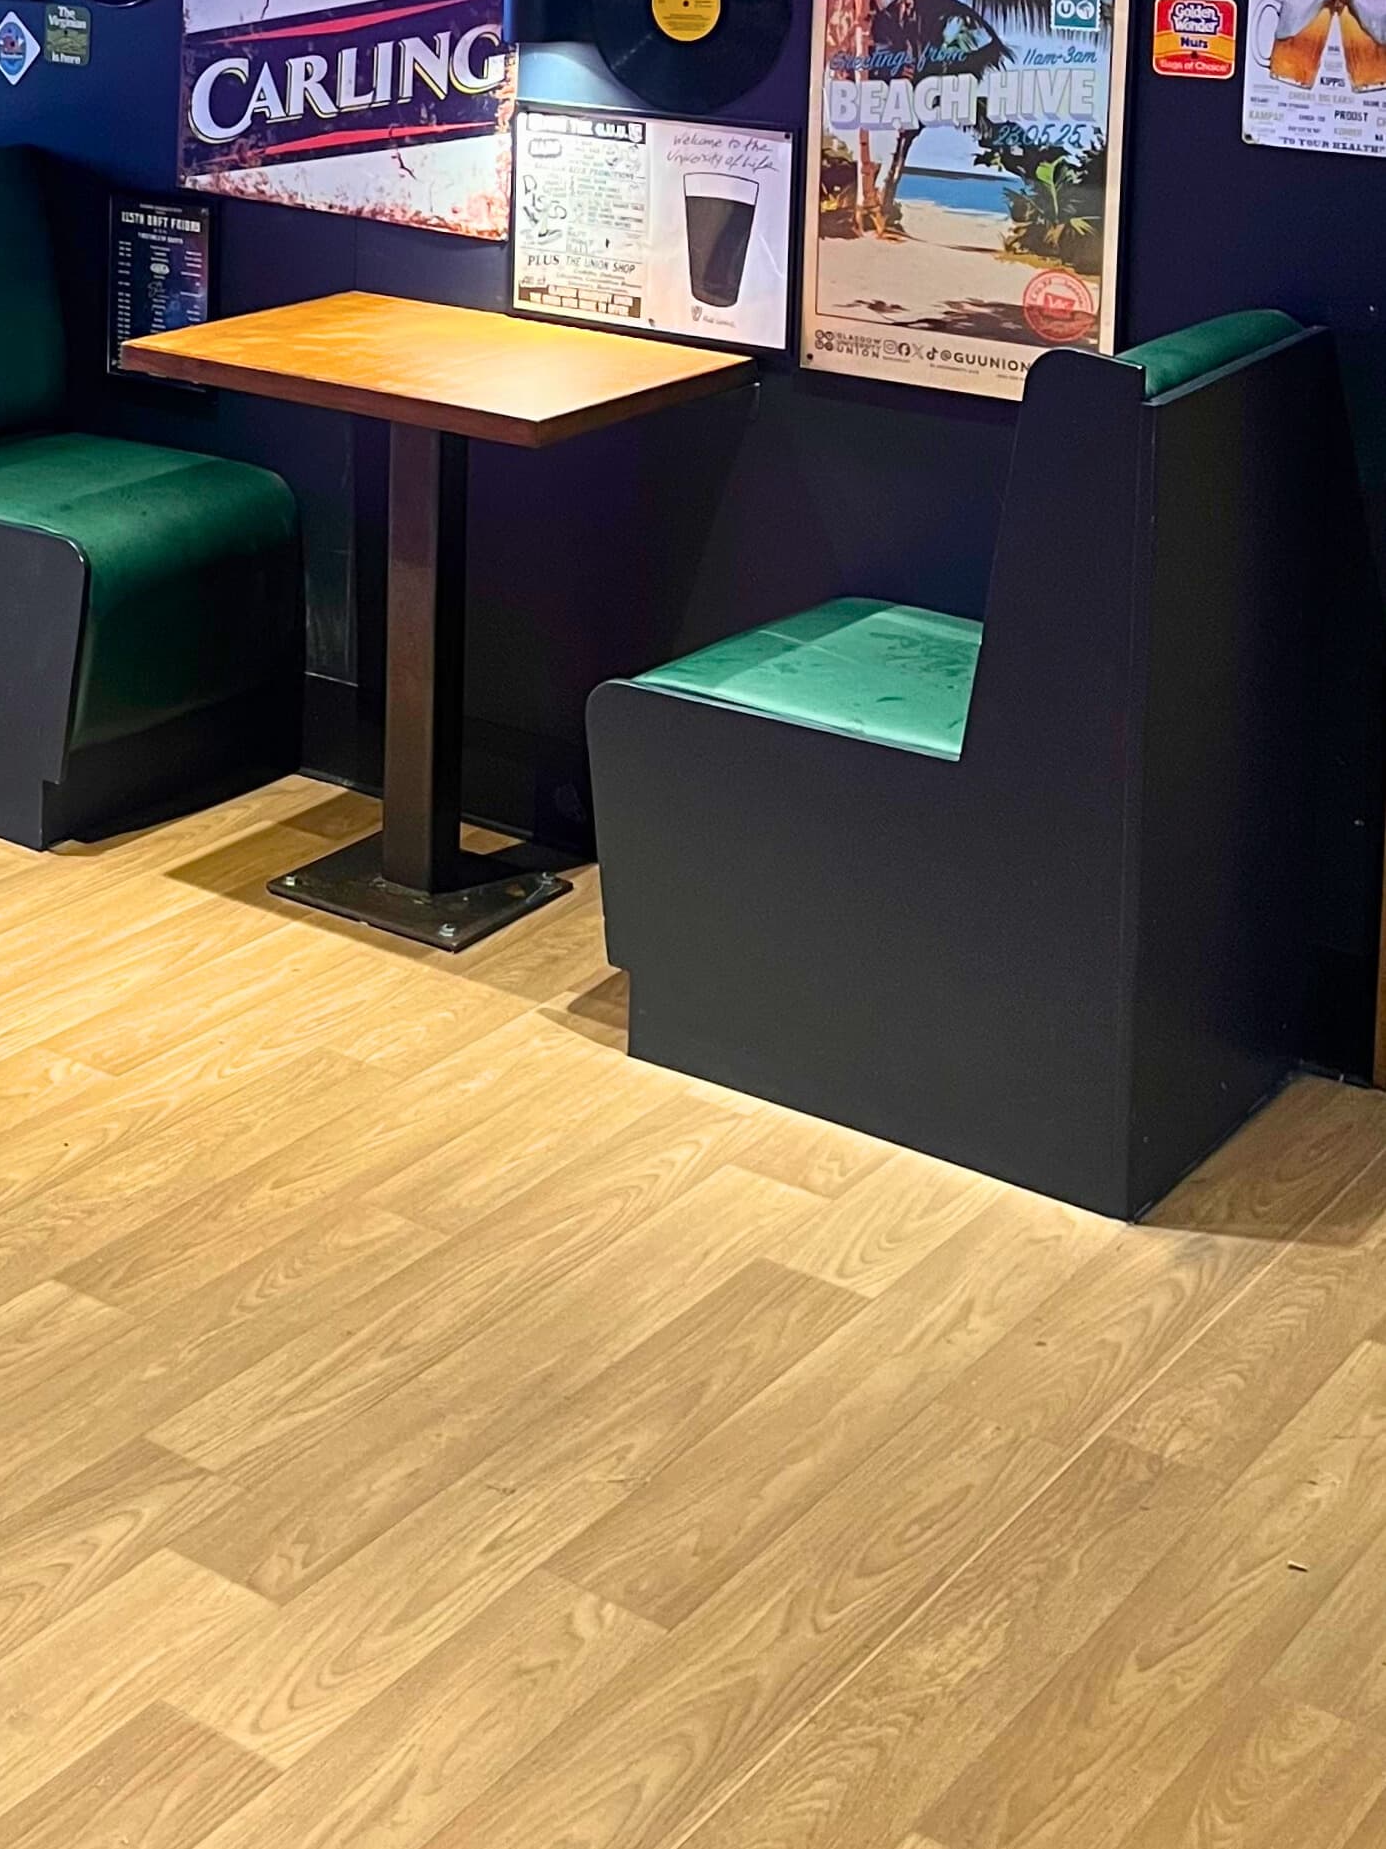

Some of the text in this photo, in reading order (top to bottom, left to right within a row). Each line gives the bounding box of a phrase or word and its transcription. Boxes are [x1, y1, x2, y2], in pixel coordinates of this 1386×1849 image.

[1175, 4, 1216, 19] Golden
[1173, 16, 1218, 33] Wonder
[1180, 37, 1209, 49] Nuts
[917, 44, 967, 72] from
[1024, 46, 1098, 66] 11am-3am
[189, 23, 506, 144] CARLING
[829, 67, 1096, 130] BEACH HIVE
[674, 133, 723, 149] Welcome
[728, 139, 742, 150] to
[1299, 137, 1330, 149] YOUR
[528, 254, 560, 266] PLUS
[613, 262, 635, 274] SHOP
